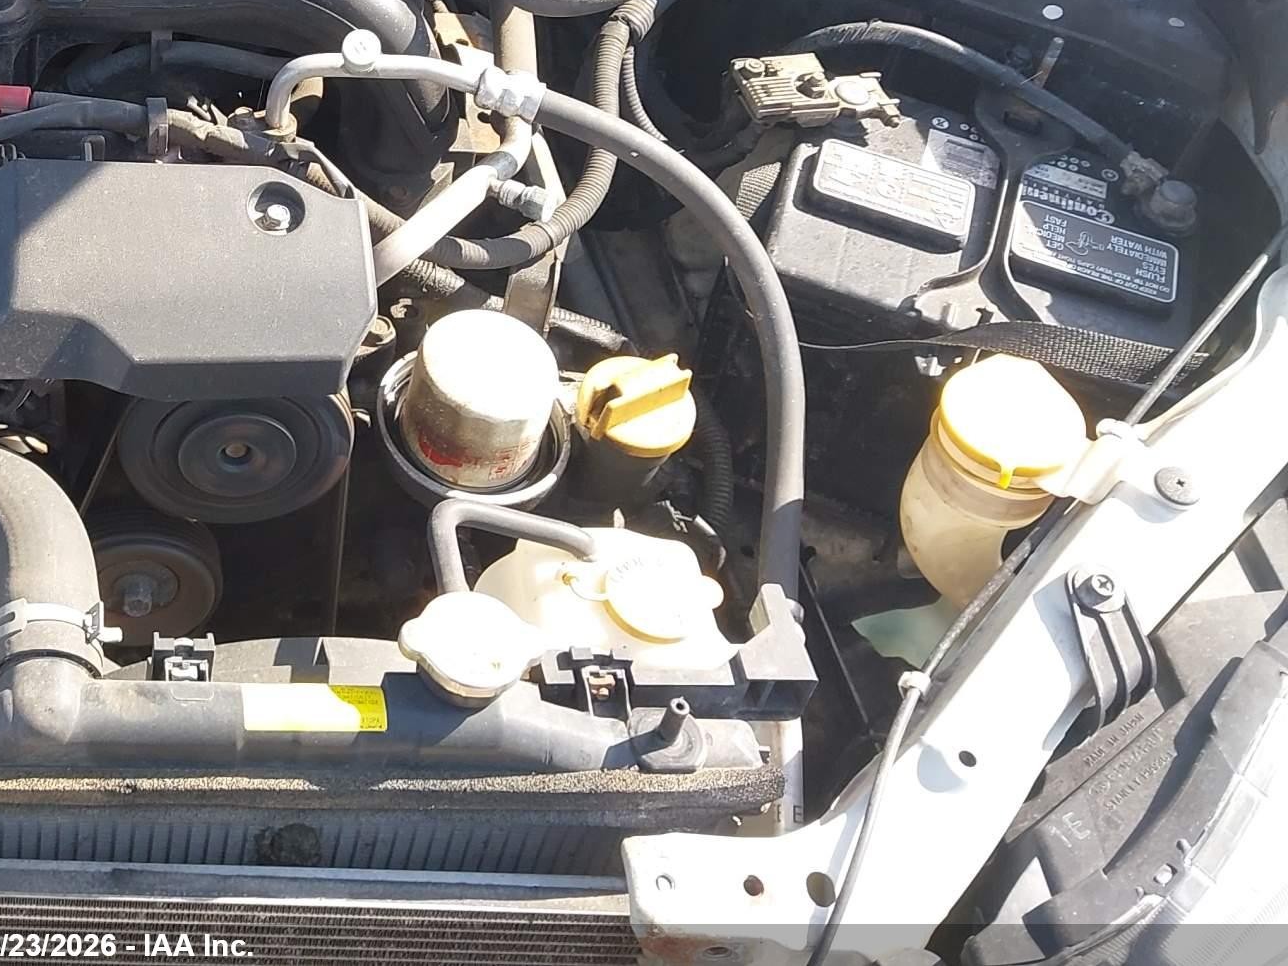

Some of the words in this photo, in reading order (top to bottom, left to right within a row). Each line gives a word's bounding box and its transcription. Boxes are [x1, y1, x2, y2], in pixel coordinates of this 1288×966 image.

[1043, 213, 1067, 226] FAST
[1042, 221, 1065, 234] HELP
[1046, 239, 1064, 250] GET
[1110, 235, 1142, 250] WATER
[1106, 242, 1167, 266] IMMEDIATELY
[1144, 244, 1167, 258] WITH
[1142, 261, 1165, 274] EYES
[1114, 271, 1130, 280] KEEP
[1135, 268, 1165, 283] FLUSH
[1139, 285, 1156, 294] KEEP
